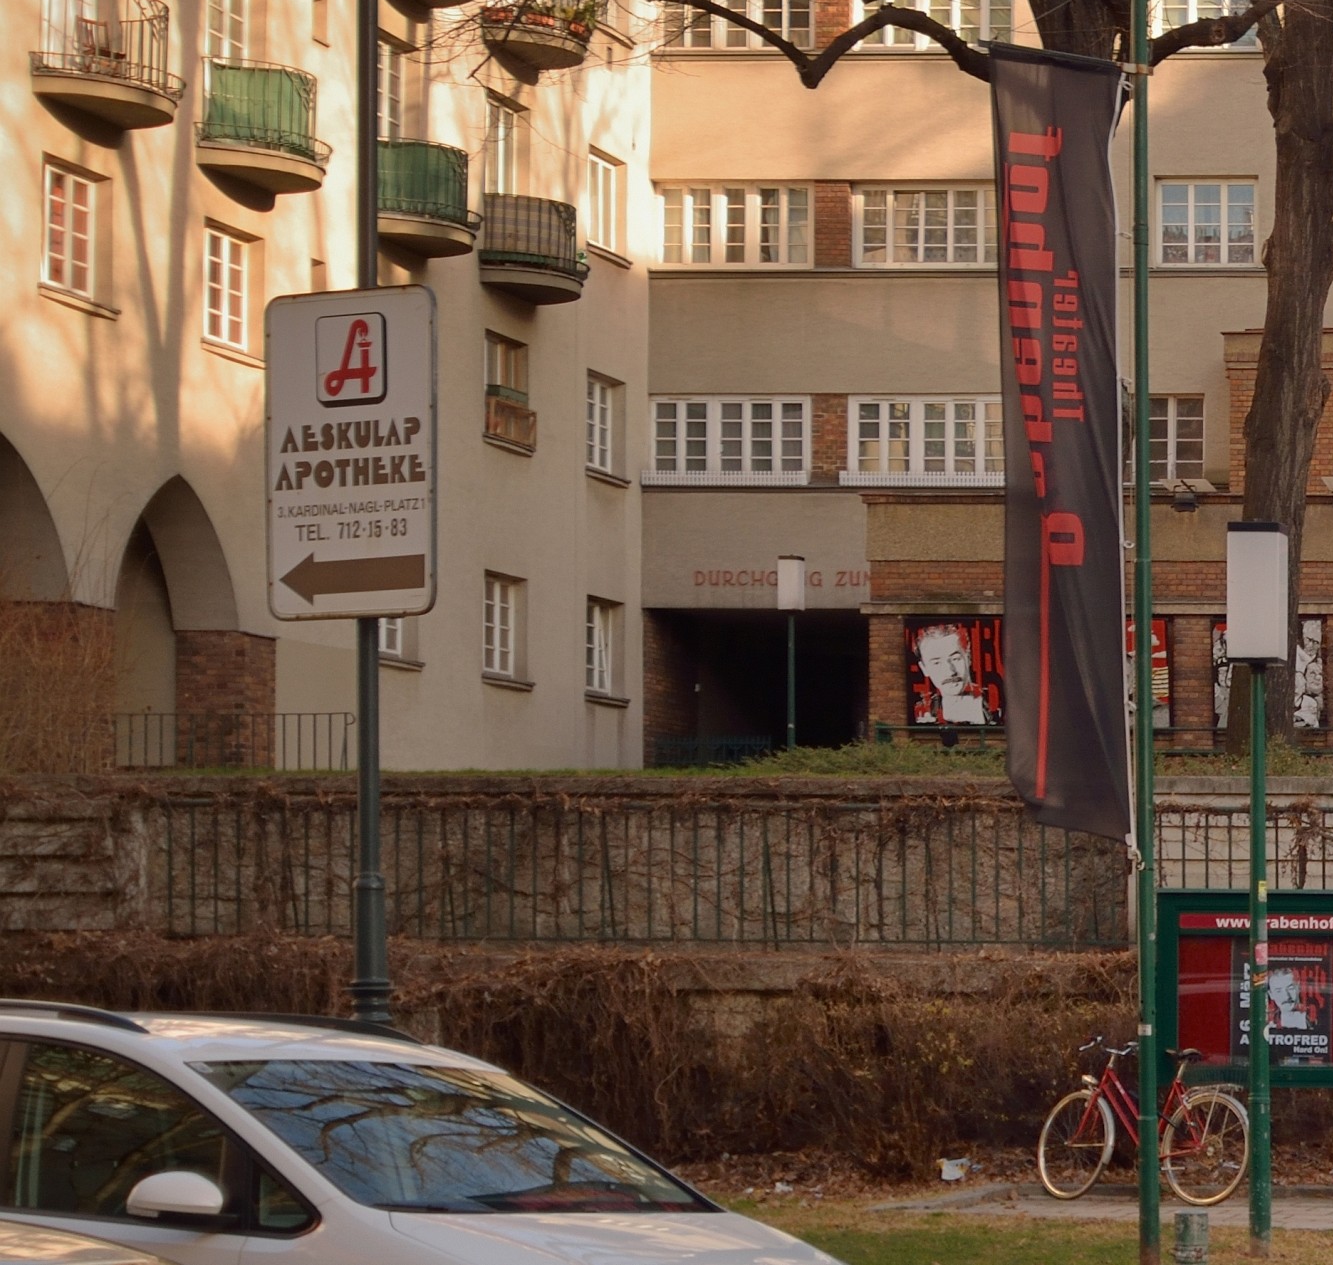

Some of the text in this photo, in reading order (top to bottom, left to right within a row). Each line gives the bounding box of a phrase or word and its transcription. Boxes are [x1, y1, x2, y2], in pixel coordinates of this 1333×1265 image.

[279, 416, 422, 454] AESKULAP
[274, 453, 427, 493] APOTHEKE
[294, 525, 330, 542] TEL.
[693, 569, 823, 588] DURCHGG
[1293, 1046, 1313, 1054] Hard
